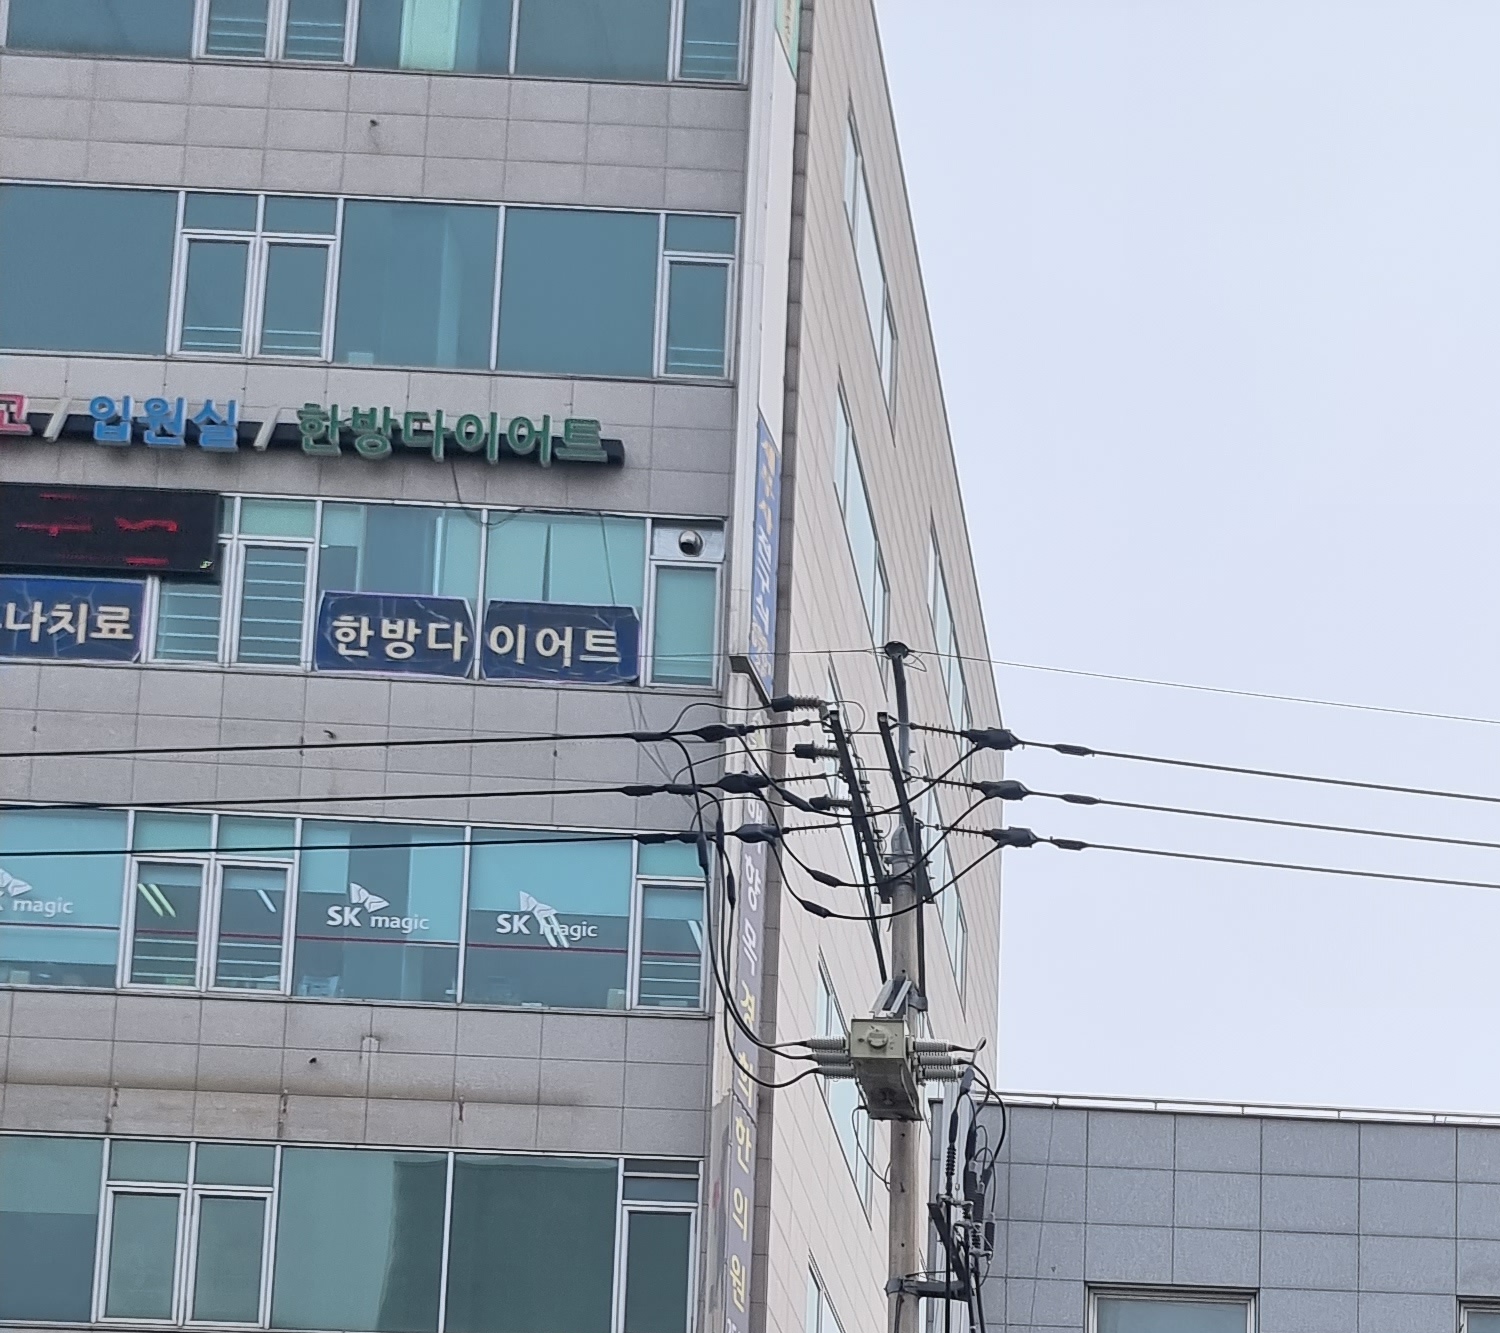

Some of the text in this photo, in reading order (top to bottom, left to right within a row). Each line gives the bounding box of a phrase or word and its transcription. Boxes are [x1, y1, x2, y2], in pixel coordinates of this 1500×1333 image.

[90, 395, 240, 452] 입원실
[297, 402, 609, 470] 한방다이어트
[0, 601, 135, 644] 나치료
[12, 897, 74, 918] magic
[326, 905, 430, 934] SK magic
[496, 913, 531, 935] SK
